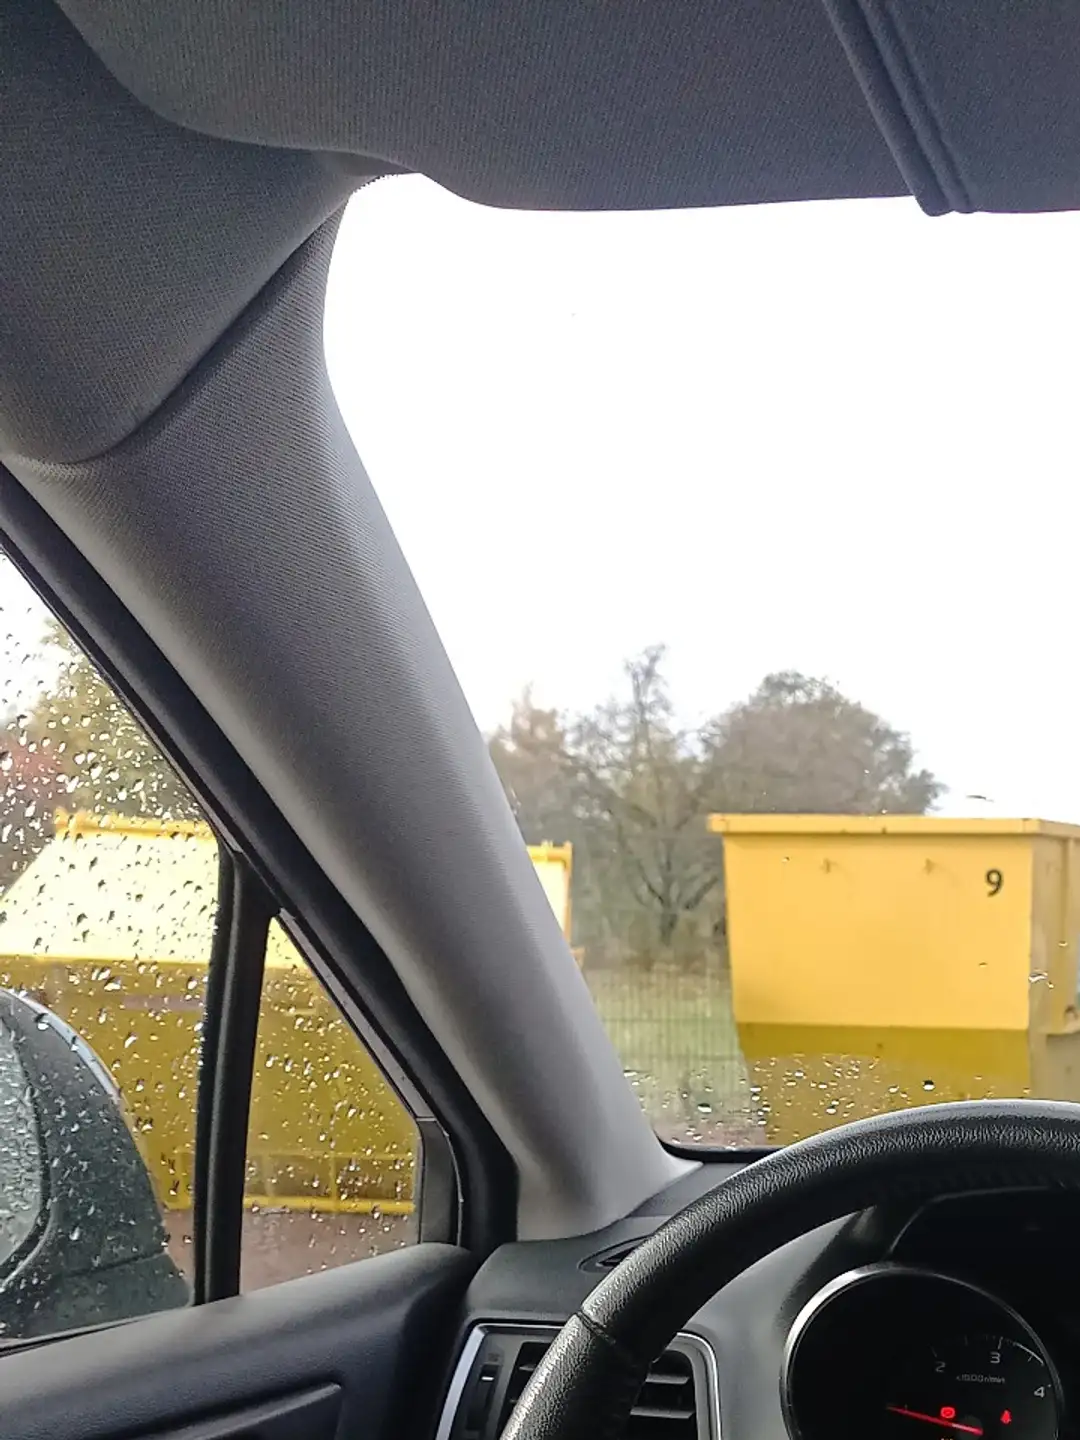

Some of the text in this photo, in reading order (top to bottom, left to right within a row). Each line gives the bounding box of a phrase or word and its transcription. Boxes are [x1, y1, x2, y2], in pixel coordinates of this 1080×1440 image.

[986, 869, 1003, 897] 9
[990, 1352, 1001, 1363] 3
[935, 1361, 946, 1373] 2
[1033, 1386, 1045, 1397] 4
